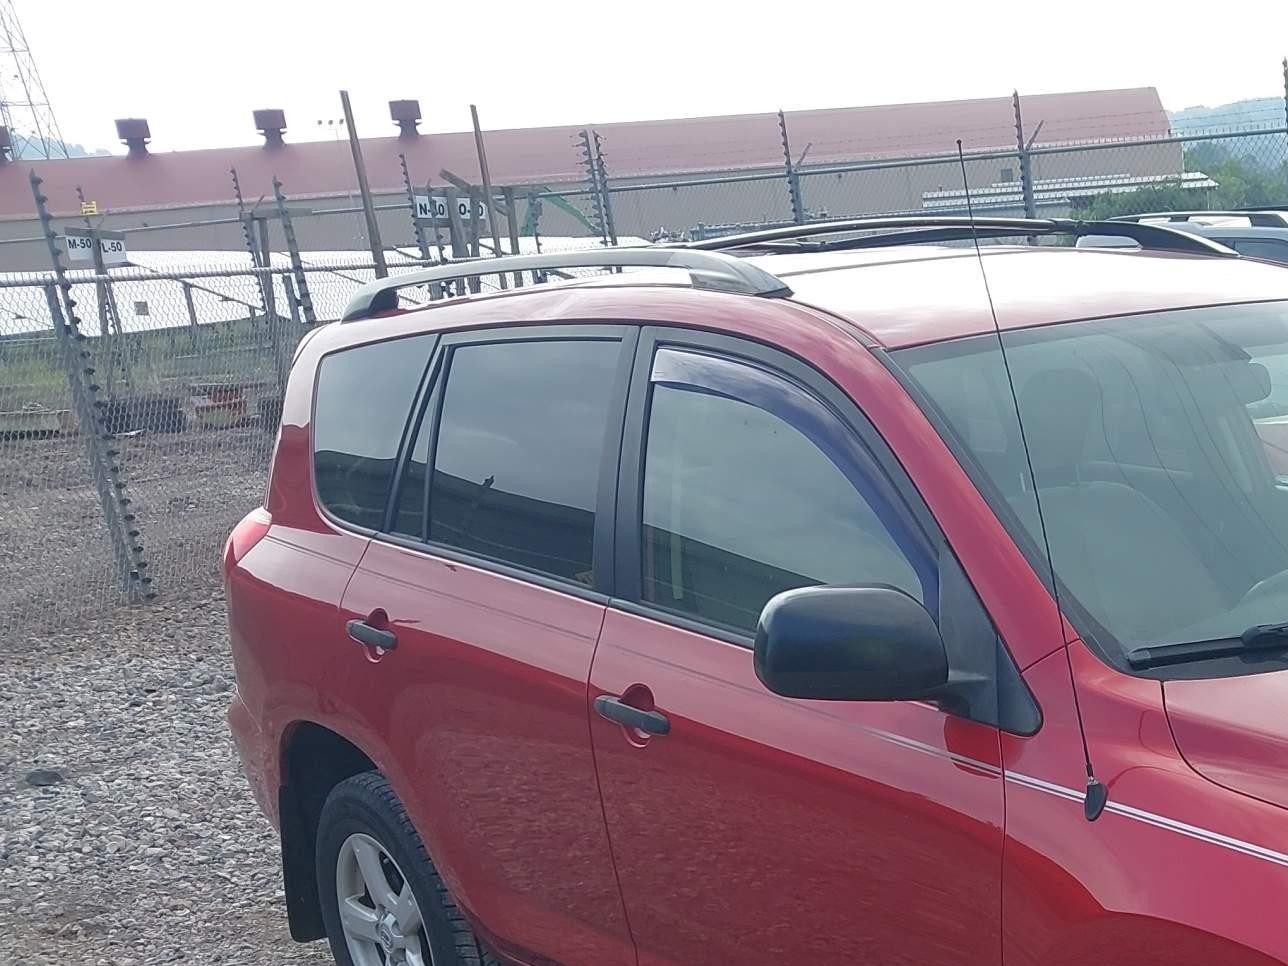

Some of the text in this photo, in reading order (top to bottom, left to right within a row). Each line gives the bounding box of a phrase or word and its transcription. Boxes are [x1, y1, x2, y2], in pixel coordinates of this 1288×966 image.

[419, 202, 445, 216] N-0
[67, 238, 92, 249] M-50
[101, 241, 122, 253] L-50
